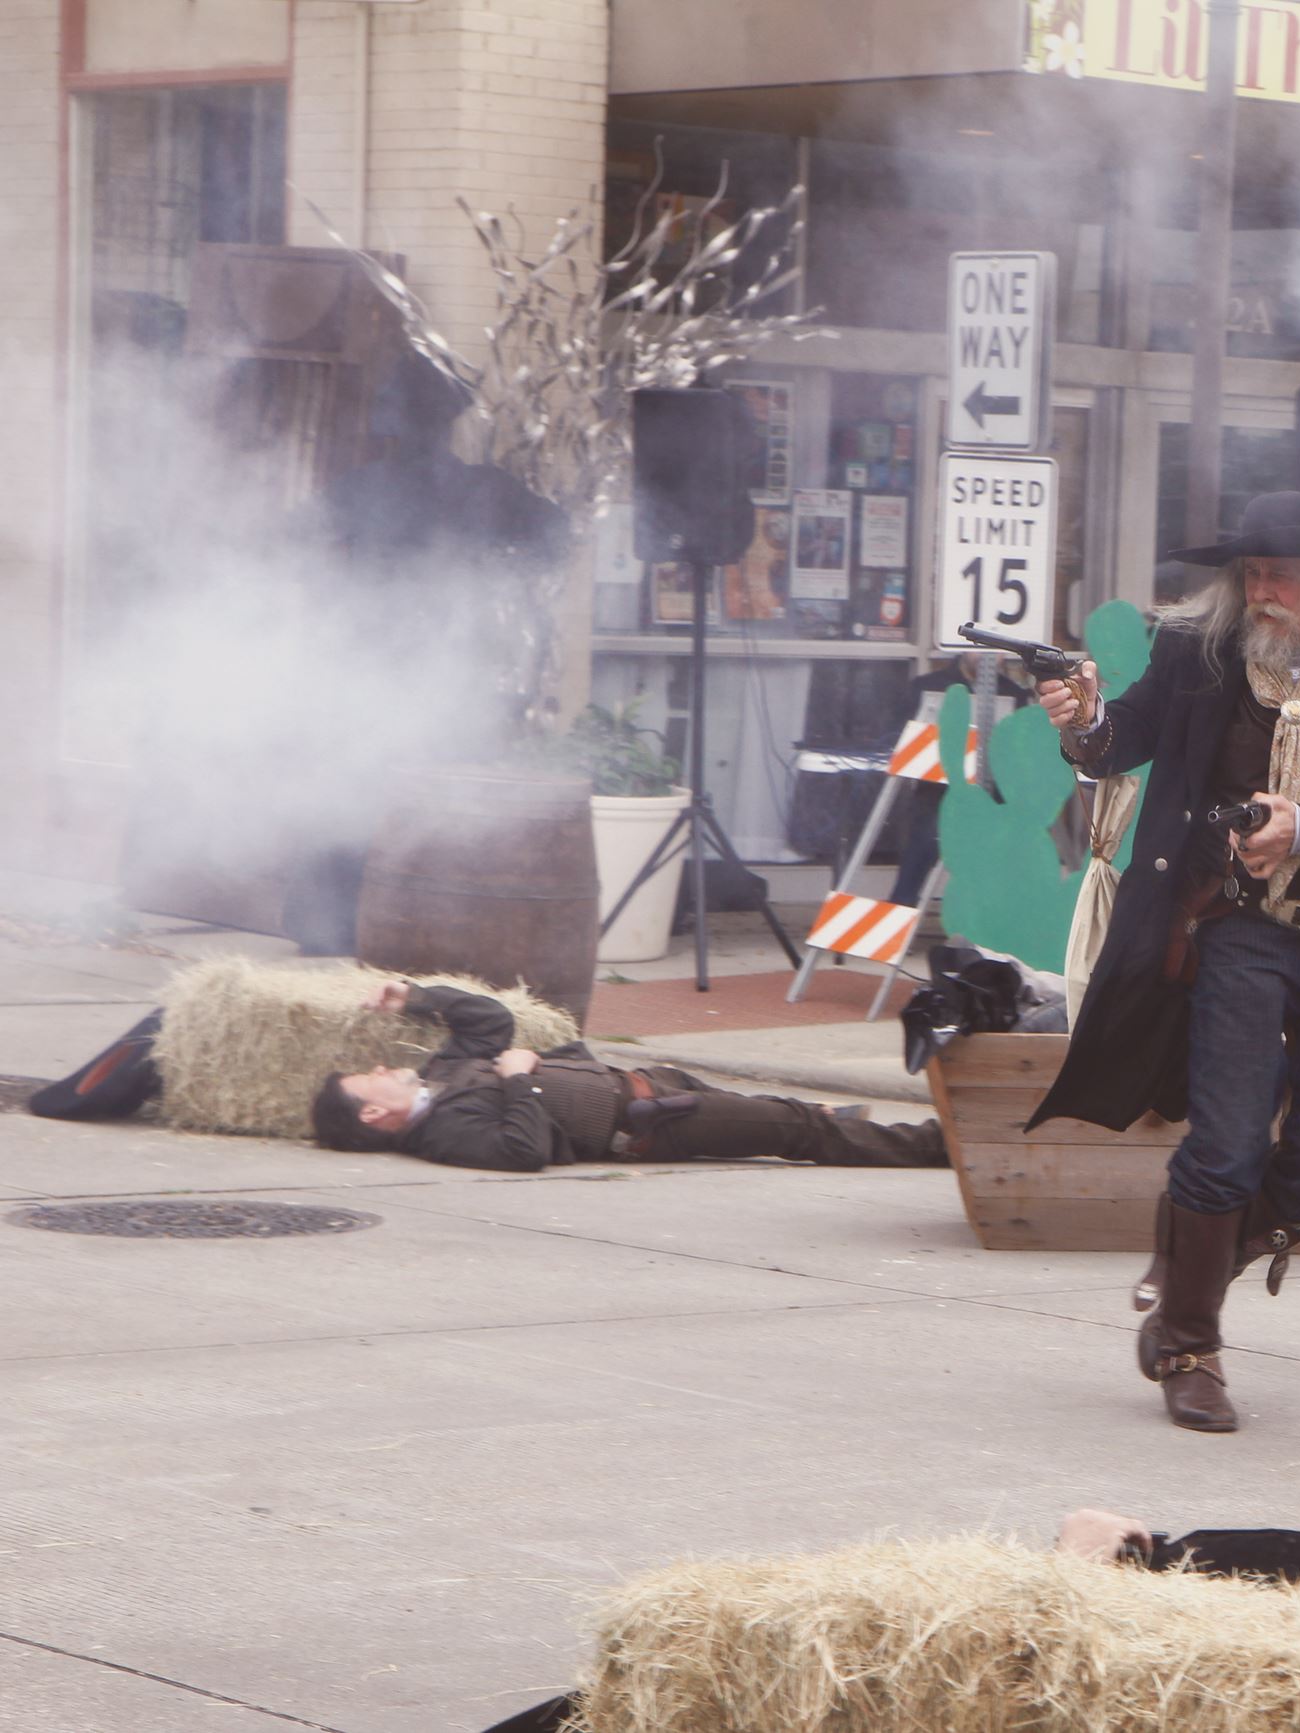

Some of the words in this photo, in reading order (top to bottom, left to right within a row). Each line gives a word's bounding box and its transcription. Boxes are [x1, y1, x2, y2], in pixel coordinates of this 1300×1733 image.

[961, 272, 1029, 315] ONE
[960, 326, 1030, 369] WAY
[952, 476, 1045, 508] SPEED
[958, 519, 1036, 547] LIMIT
[961, 556, 1029, 626] 15
